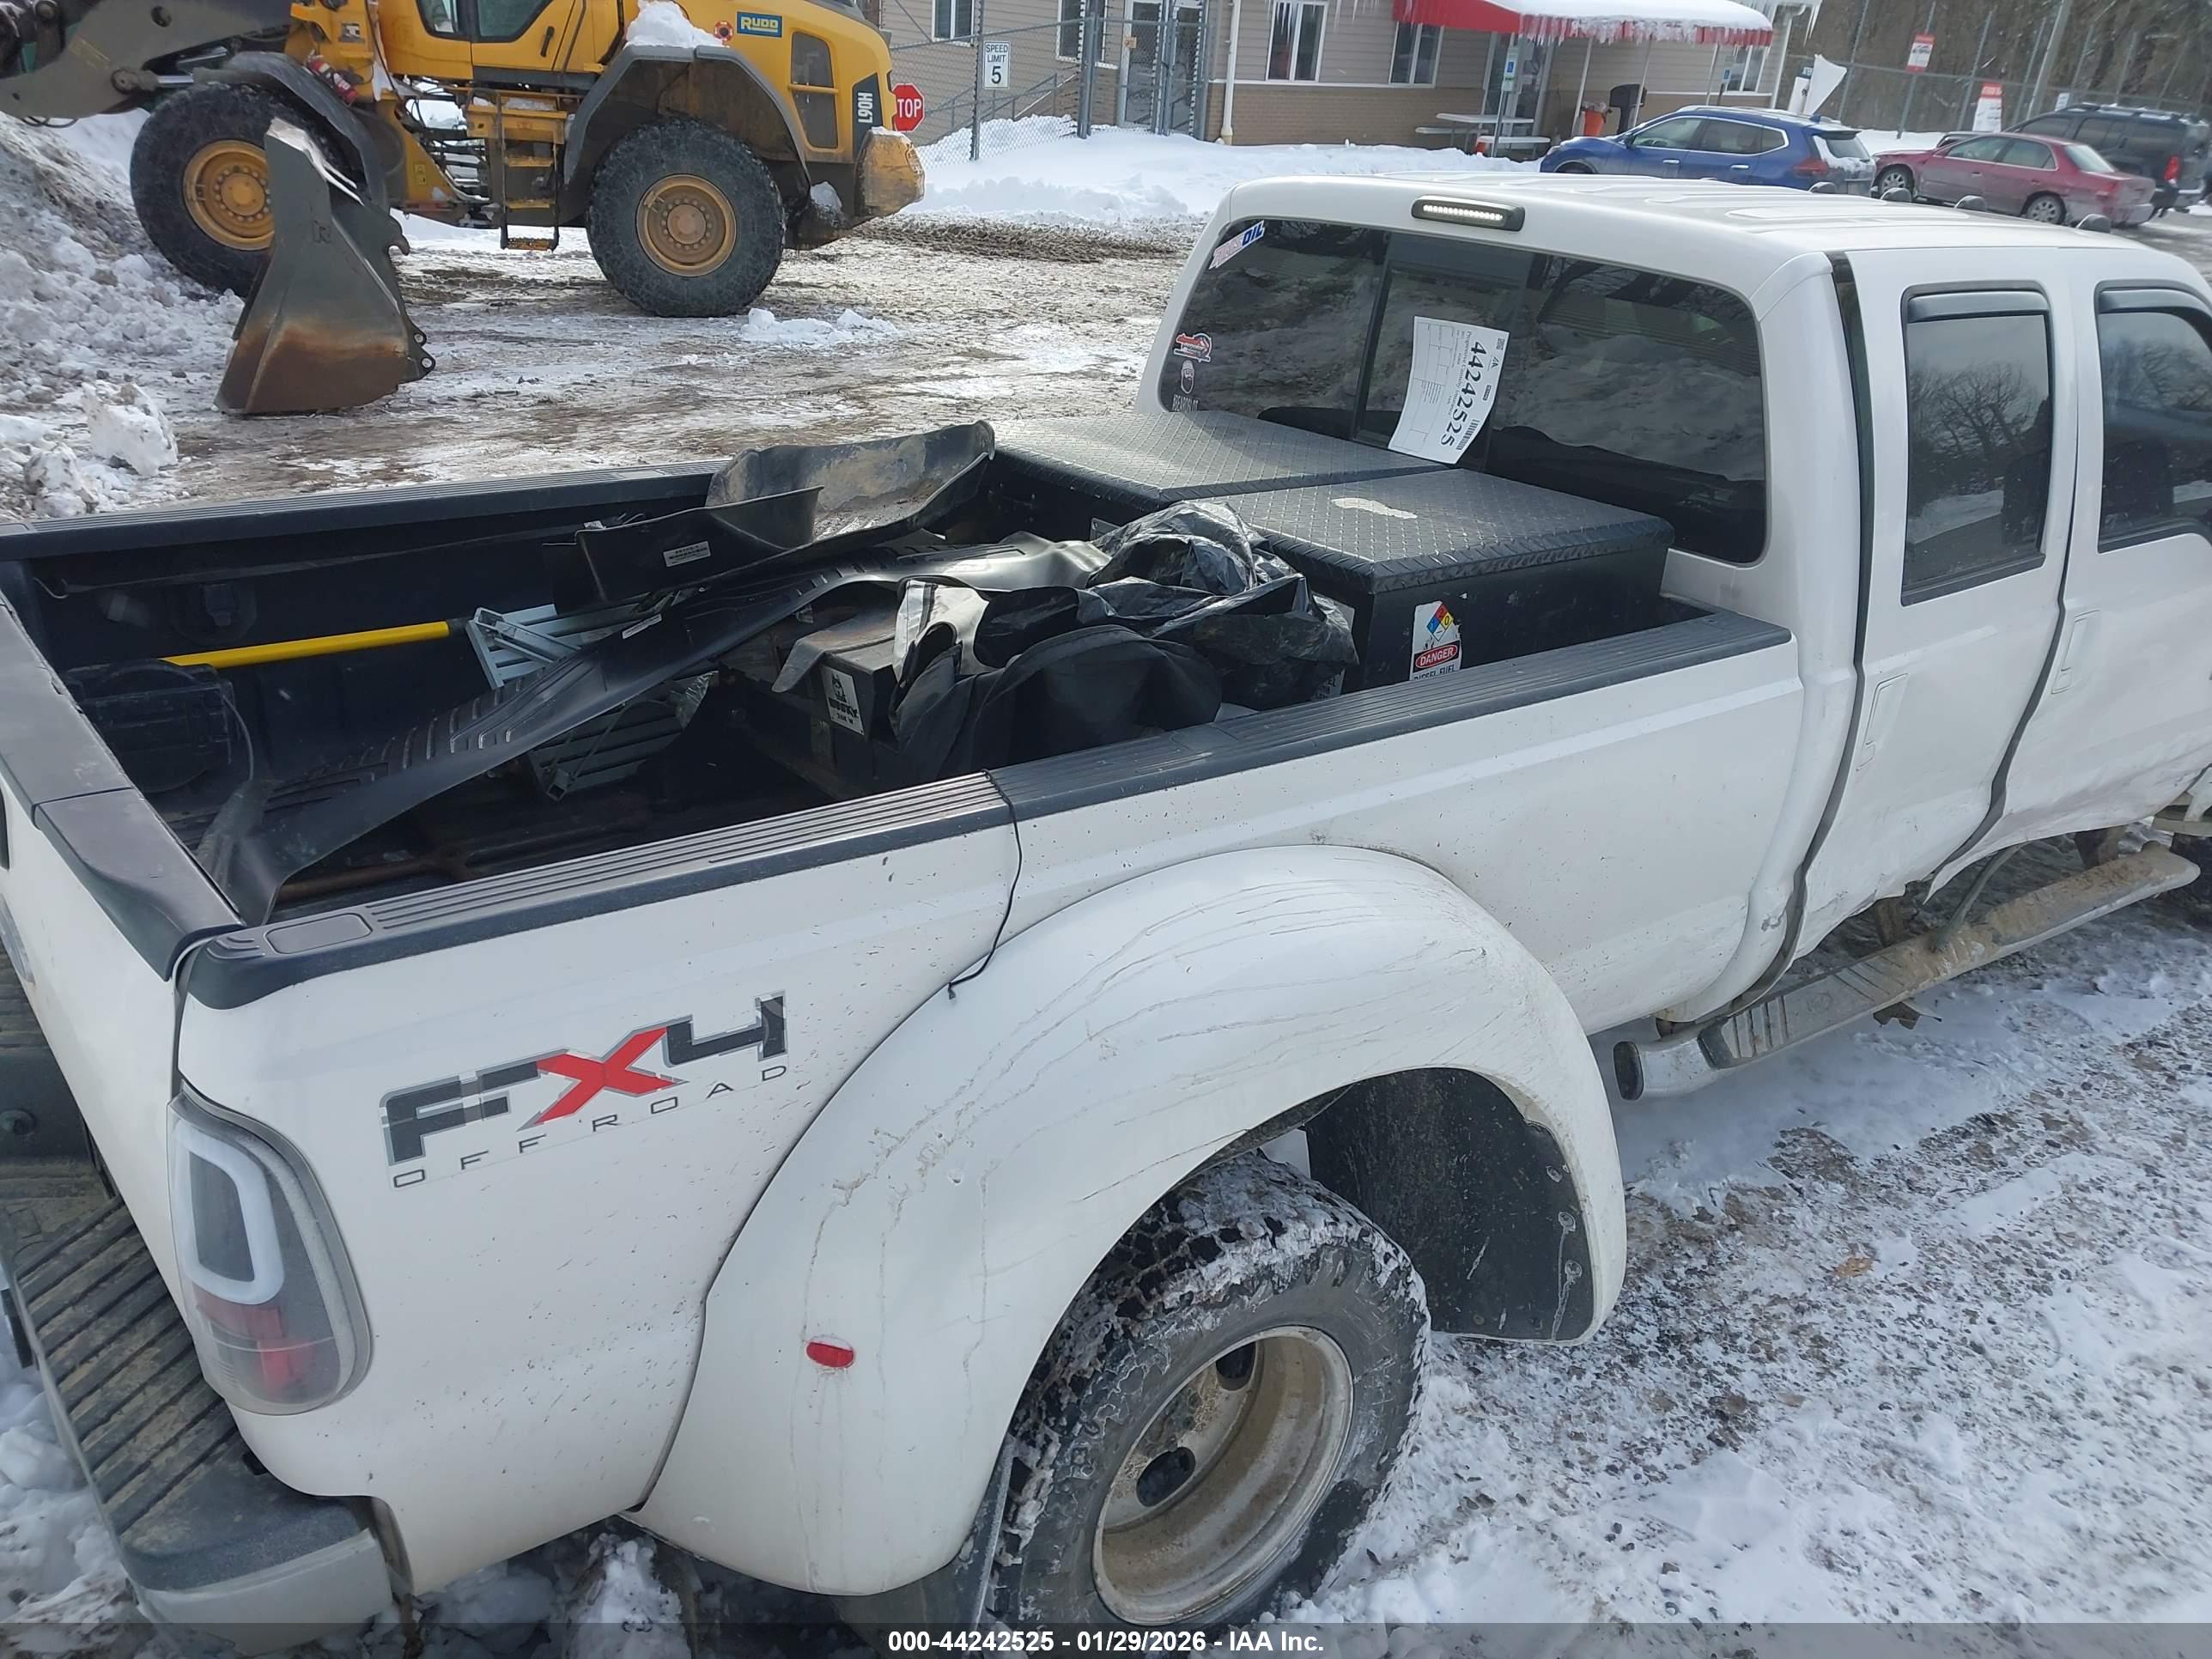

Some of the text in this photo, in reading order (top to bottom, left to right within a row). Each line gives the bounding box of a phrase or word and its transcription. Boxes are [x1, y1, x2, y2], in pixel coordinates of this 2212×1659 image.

[985, 44, 1008, 53] SPEED
[987, 54, 1006, 64] LIMIT
[991, 65, 1001, 84] 5
[858, 92, 872, 124] L90H
[896, 98, 922, 118] TOP
[1441, 341, 1487, 447] 44242525
[1419, 647, 1454, 666] DANGER
[379, 989, 789, 1166] FX4
